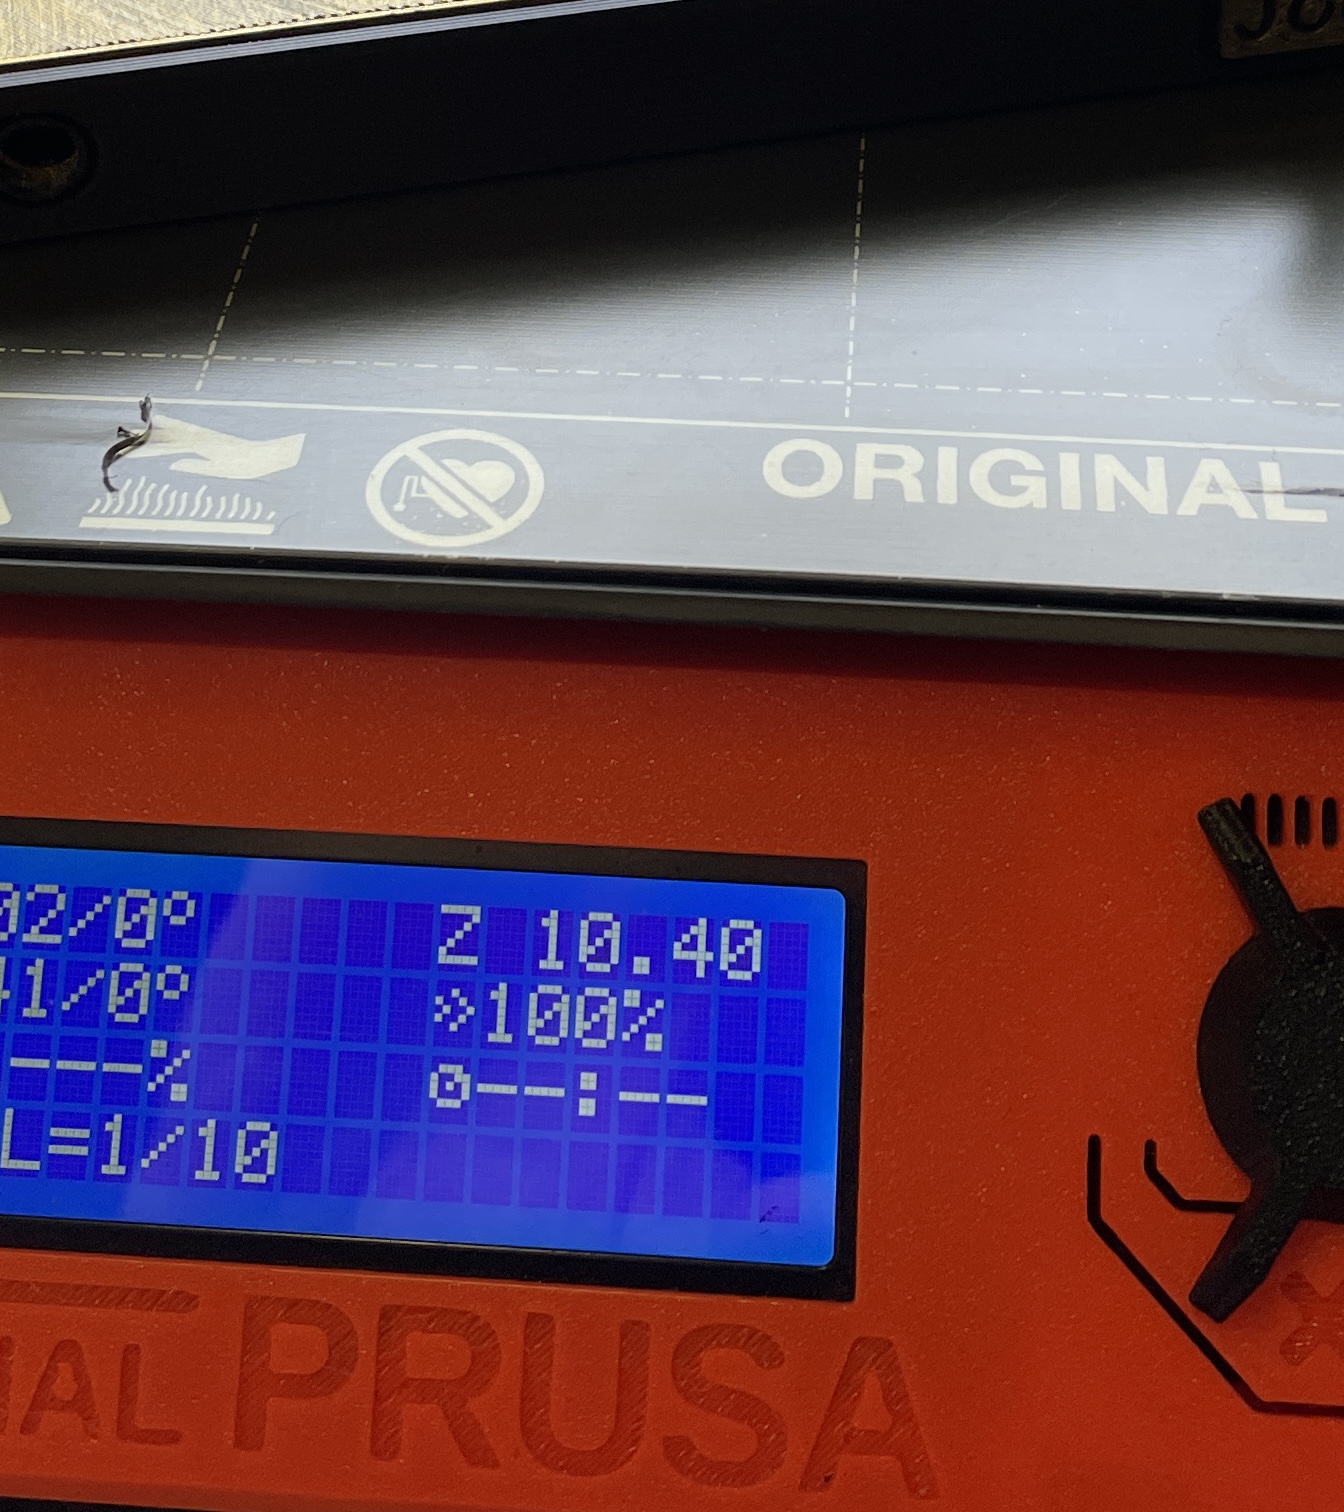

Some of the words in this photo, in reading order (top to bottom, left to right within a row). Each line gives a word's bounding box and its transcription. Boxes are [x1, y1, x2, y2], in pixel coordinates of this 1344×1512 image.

[762, 438, 1328, 523] ORIGINAL
[437, 904, 482, 966] Z
[539, 909, 763, 982] 10.40
[487, 982, 665, 1053] 100%
[0, 1107, 279, 1184] L=1/10
[232, 1294, 940, 1500] PRUSA
